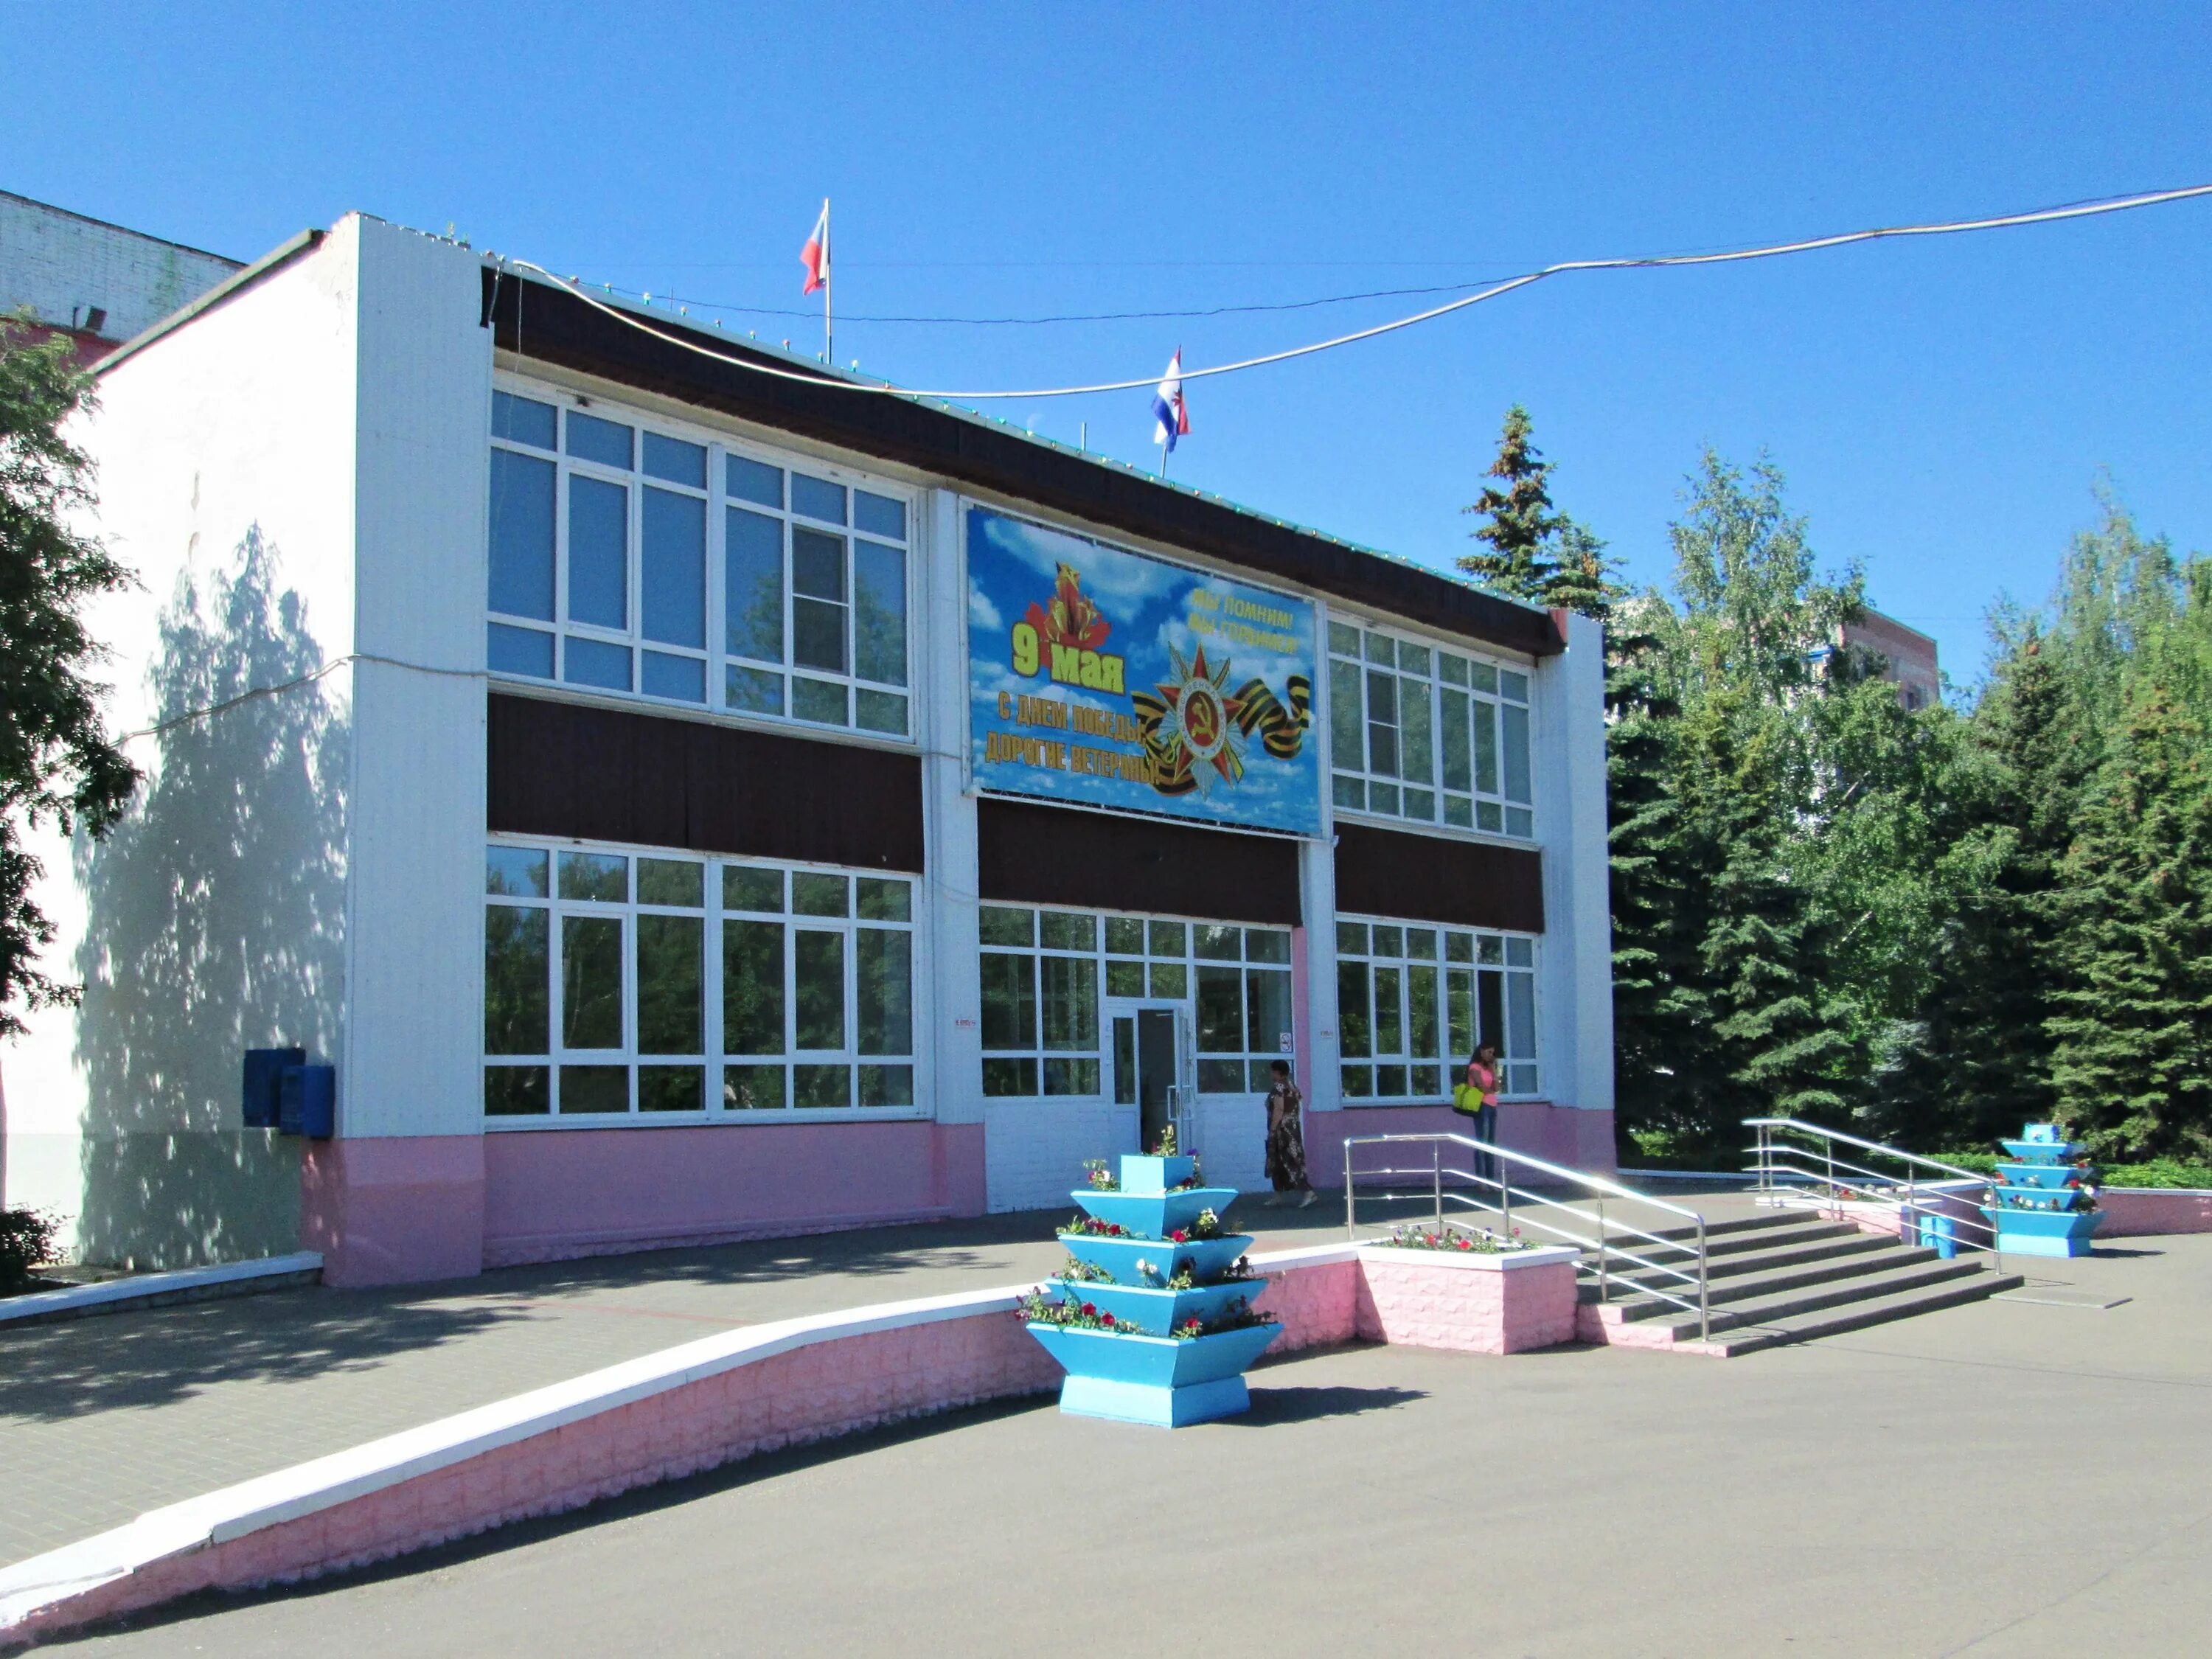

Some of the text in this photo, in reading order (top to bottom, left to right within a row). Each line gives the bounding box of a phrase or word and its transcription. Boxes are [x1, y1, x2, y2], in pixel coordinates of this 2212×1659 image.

[1225, 596, 1294, 630] ПОМНИМ!
[1012, 622, 1040, 678] 9
[998, 690, 1011, 720] С
[1016, 694, 1068, 731] ДНЕМ
[985, 731, 1066, 771] ДОРОГИЕ
